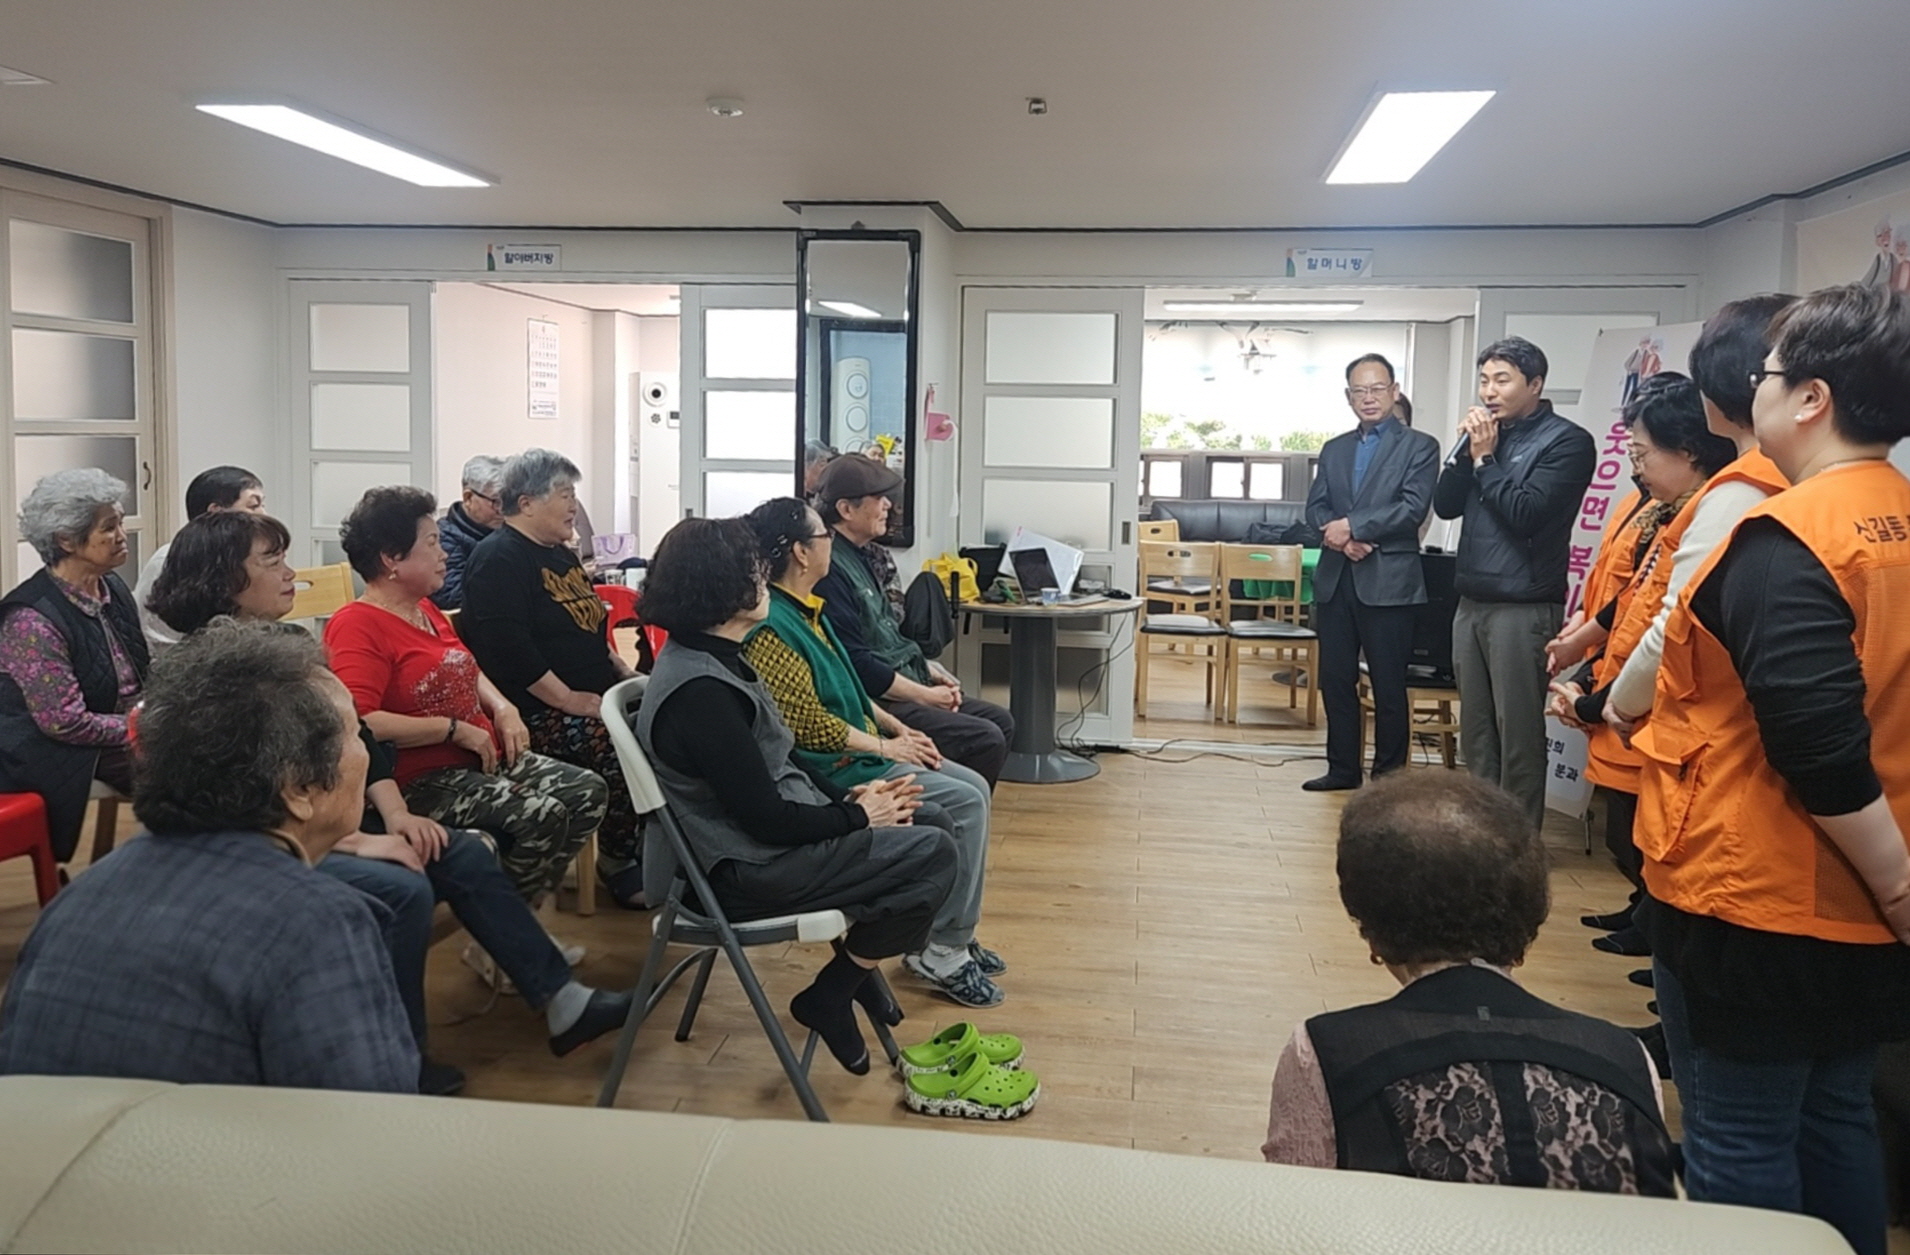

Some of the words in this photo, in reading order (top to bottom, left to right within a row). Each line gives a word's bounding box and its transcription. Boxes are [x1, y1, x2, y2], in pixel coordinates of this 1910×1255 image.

[504, 252, 554, 264] 할아버지방
[1307, 257, 1362, 271] 할머니방
[1853, 515, 1908, 543] 신길동
[1554, 762, 1579, 782] 분과
